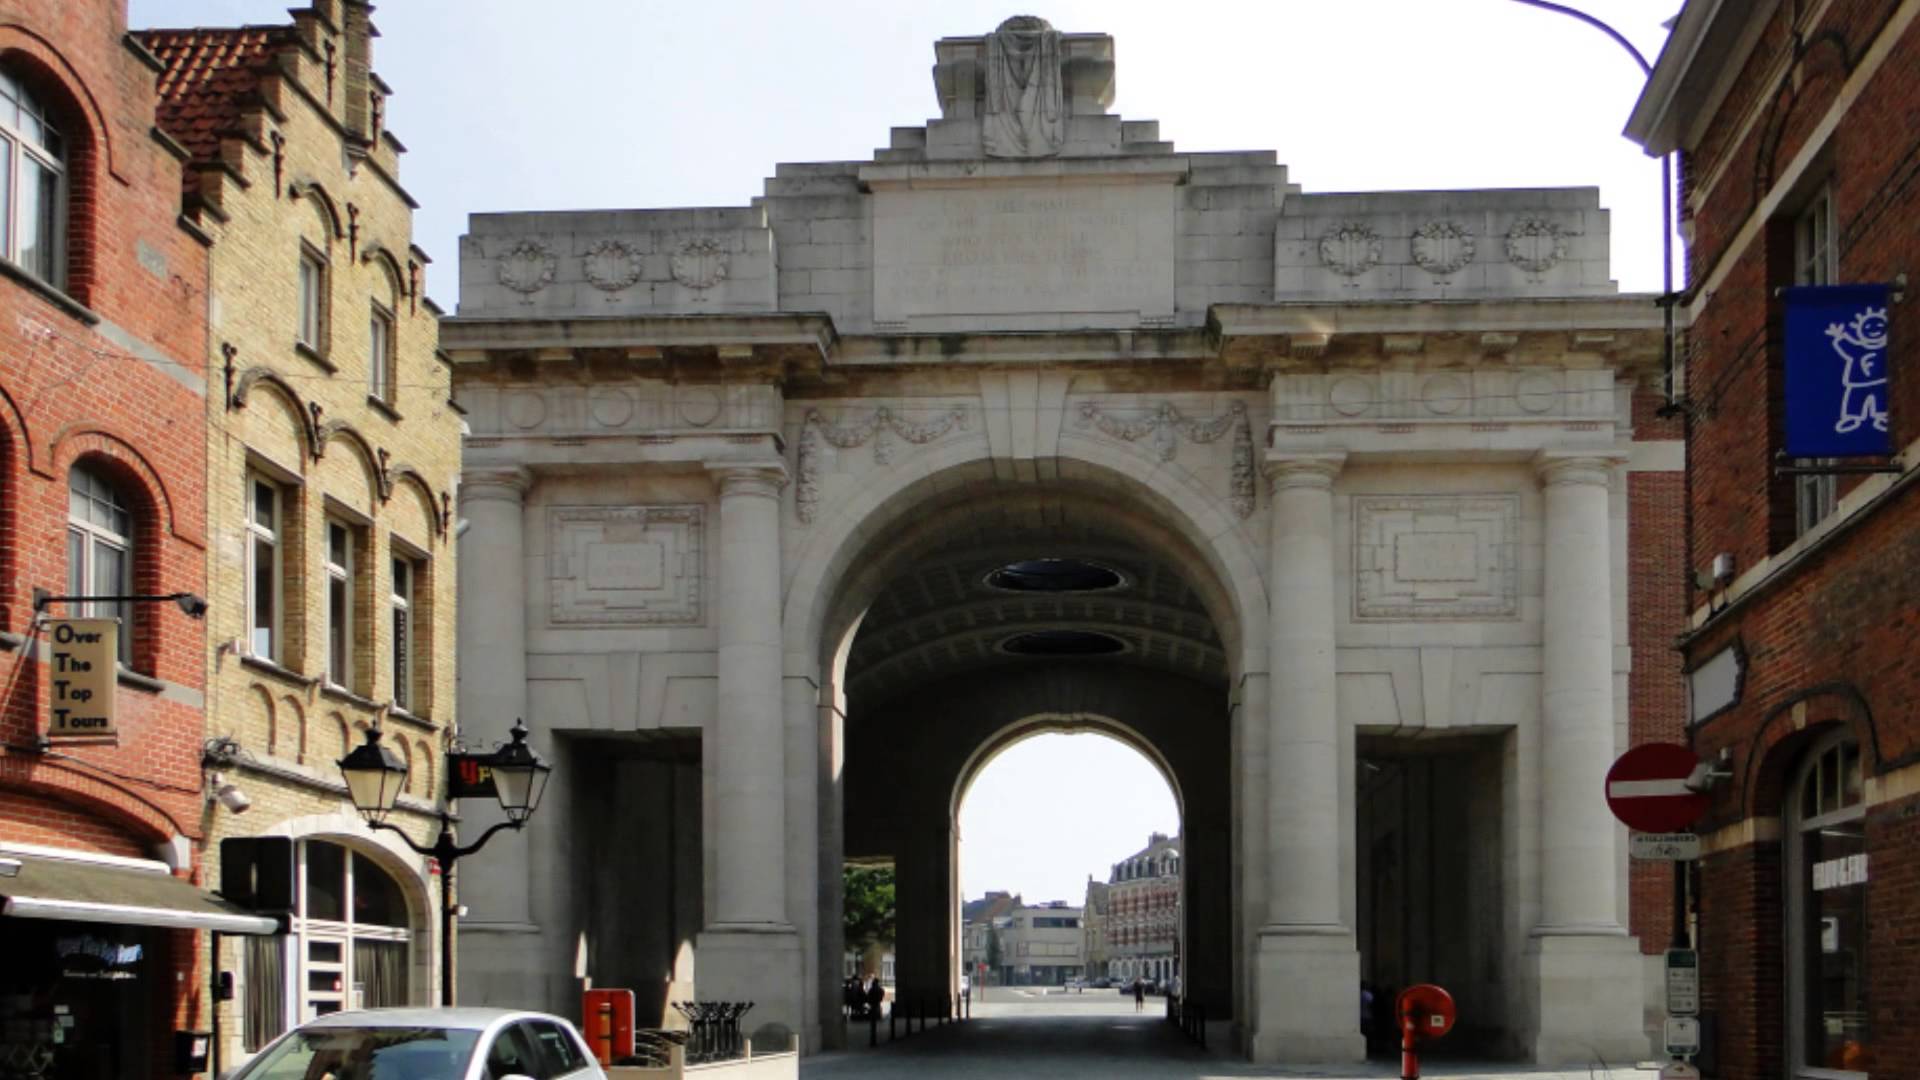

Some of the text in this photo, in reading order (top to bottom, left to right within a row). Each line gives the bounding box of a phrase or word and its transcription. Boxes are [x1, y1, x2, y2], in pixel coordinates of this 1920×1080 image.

[55, 624, 102, 643] Over
[54, 653, 92, 672] The
[54, 680, 93, 702] Top
[54, 709, 108, 728] Tours
